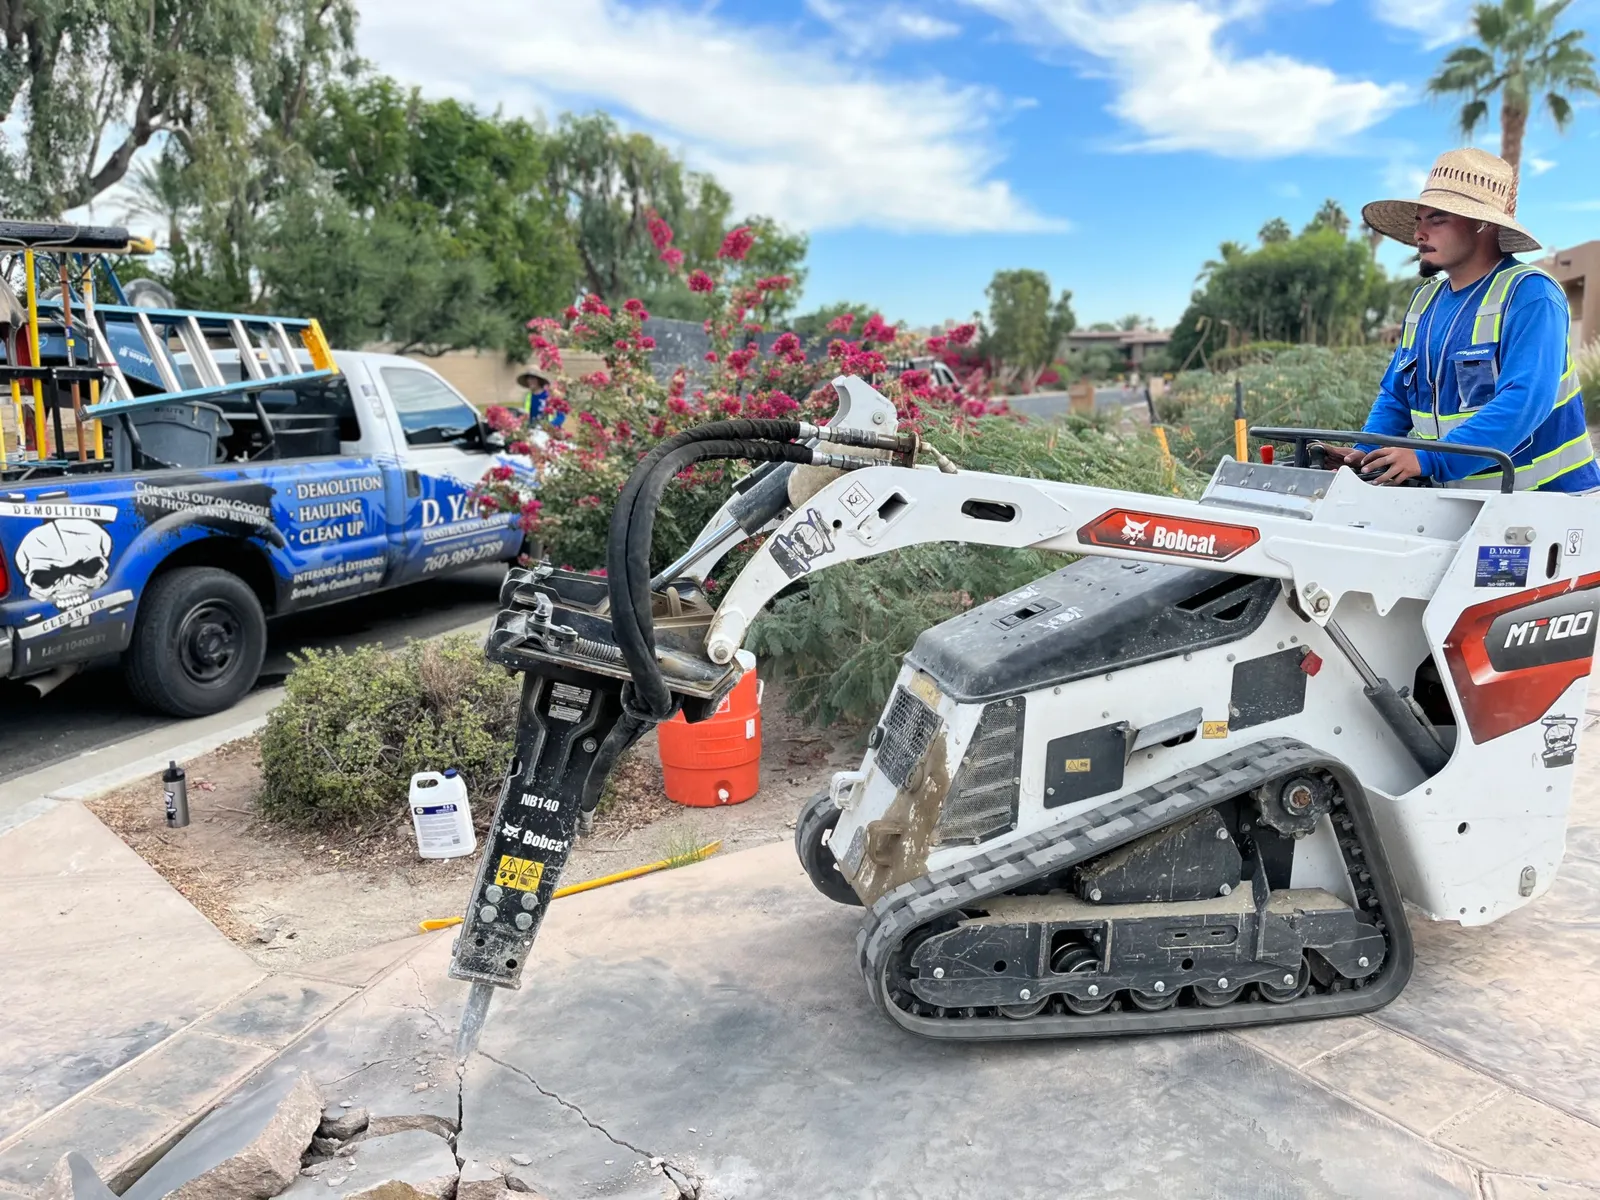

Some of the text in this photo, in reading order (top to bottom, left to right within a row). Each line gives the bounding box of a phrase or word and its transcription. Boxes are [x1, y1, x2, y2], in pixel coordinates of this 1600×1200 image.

[134, 481, 271, 517] CHECK US OUT ON GOOGLE
[297, 476, 382, 500] DEMOLITION
[13, 504, 102, 518] DEMOLITION
[136, 494, 267, 526] FOR PHOTOS AND REVIEWS
[299, 500, 362, 523] HAULING
[422, 498, 445, 528] D.
[299, 521, 365, 545] CLEAN UP
[1152, 525, 1217, 555] Bobcat
[1489, 547, 1521, 555] D. YANEZ
[293, 555, 385, 584] INTERIORS & EXTERIORS
[42, 599, 105, 632] CLEAN UP
[520, 793, 560, 812] NB140
